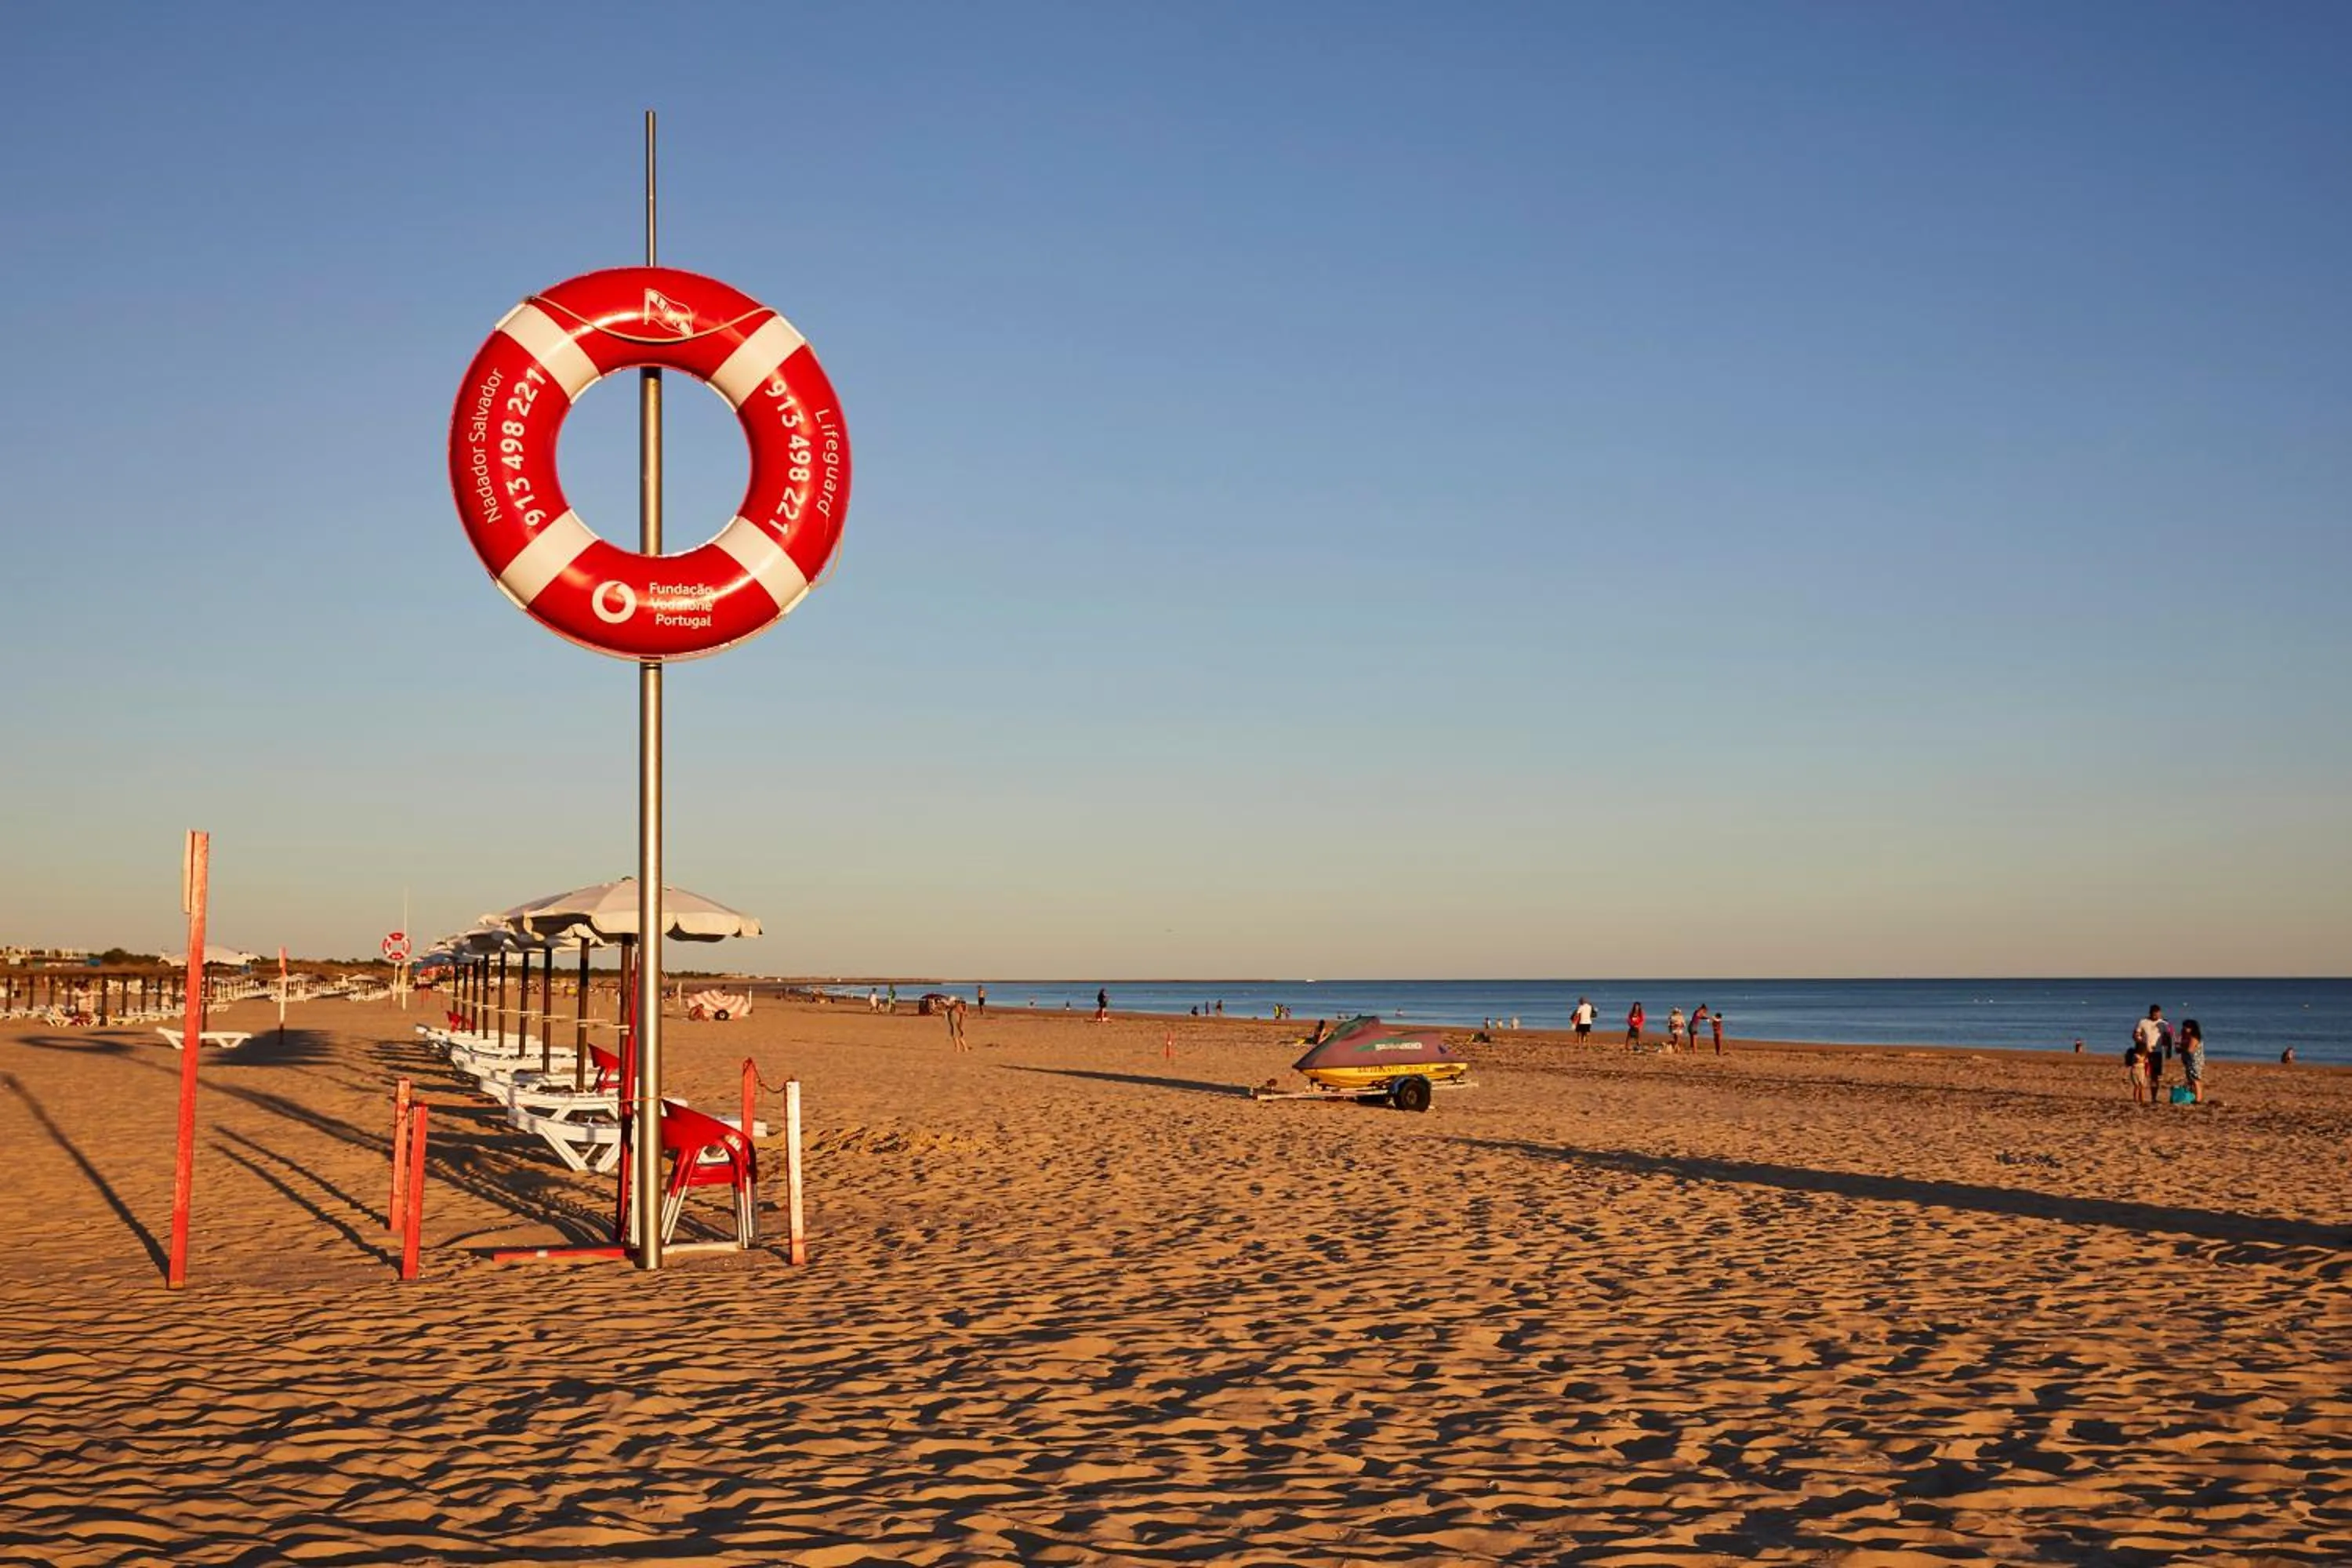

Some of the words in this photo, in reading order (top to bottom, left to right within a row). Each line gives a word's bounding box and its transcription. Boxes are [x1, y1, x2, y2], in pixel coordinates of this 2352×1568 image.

[469, 368, 503, 442] Salvador
[507, 367, 546, 417] 221
[764, 380, 804, 427] 913
[500, 420, 524, 470] 498
[788, 434, 811, 482] 498
[815, 408, 839, 517] Lifeguard
[471, 446, 503, 524] Nadador
[506, 477, 546, 526] 913
[768, 487, 806, 535] 221
[649, 583, 713, 597] Fundação
[655, 614, 712, 629] Portugal
